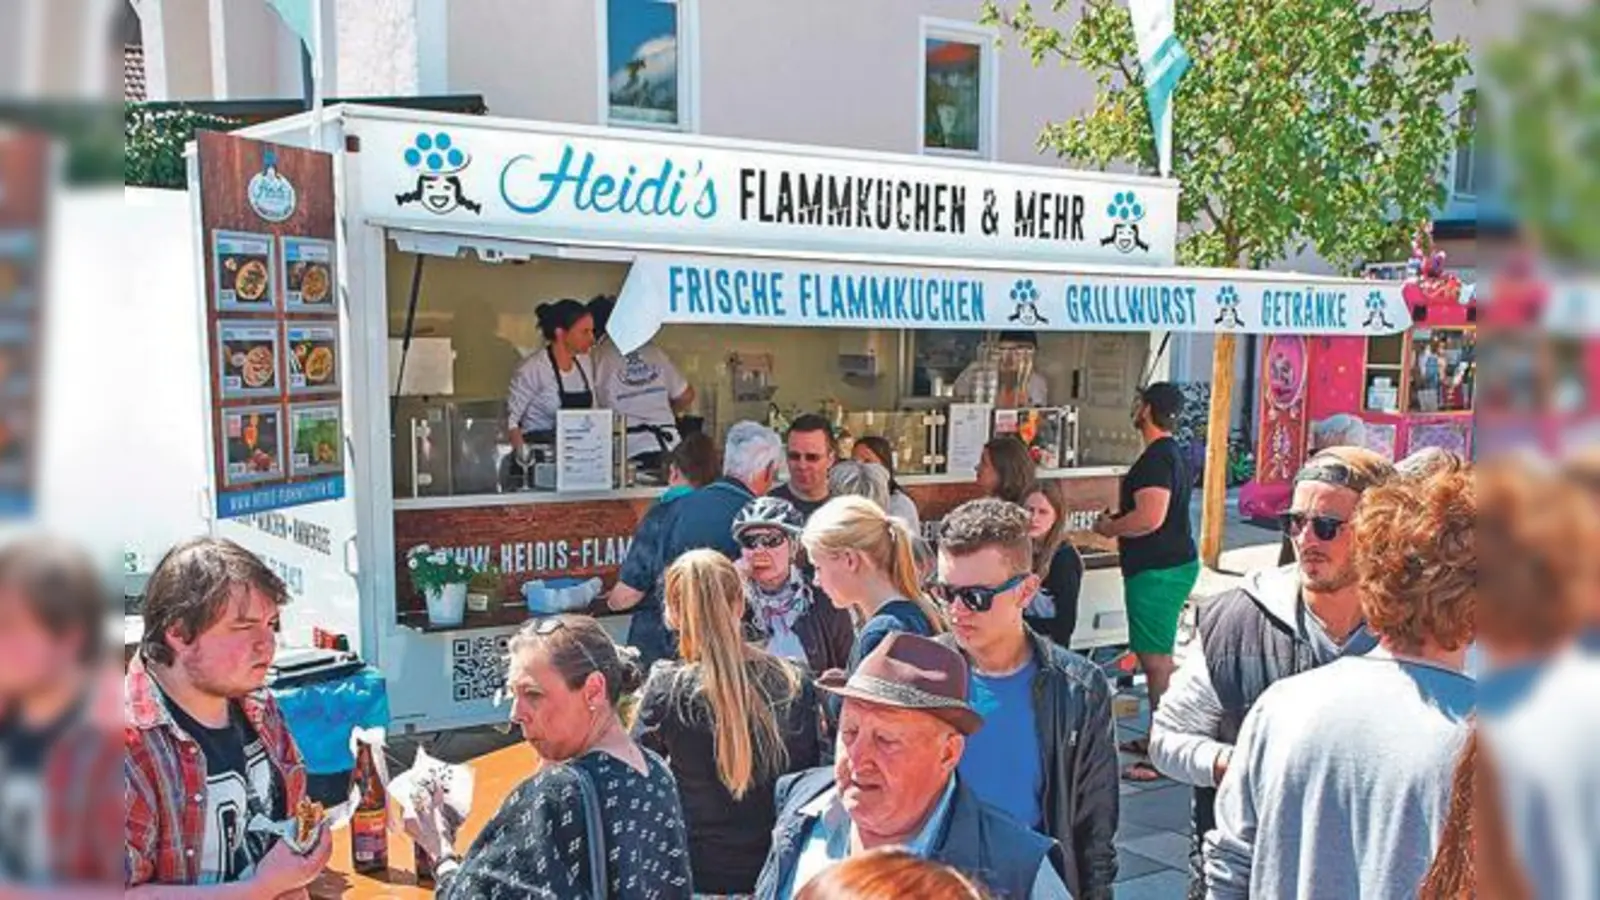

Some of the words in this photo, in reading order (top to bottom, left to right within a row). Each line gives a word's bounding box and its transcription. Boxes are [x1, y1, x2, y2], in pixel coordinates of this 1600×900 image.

[500, 143, 718, 219] Heidi's
[739, 168, 967, 235] FLAMMKUCHEN
[981, 188, 1000, 236] &
[1013, 190, 1086, 241] MEHR
[668, 265, 787, 316] FRISCHE
[799, 273, 986, 323] FLAMMKUCHEN
[1065, 284, 1197, 325] GRILLWURST
[1262, 287, 1347, 328] GETRÄNKE
